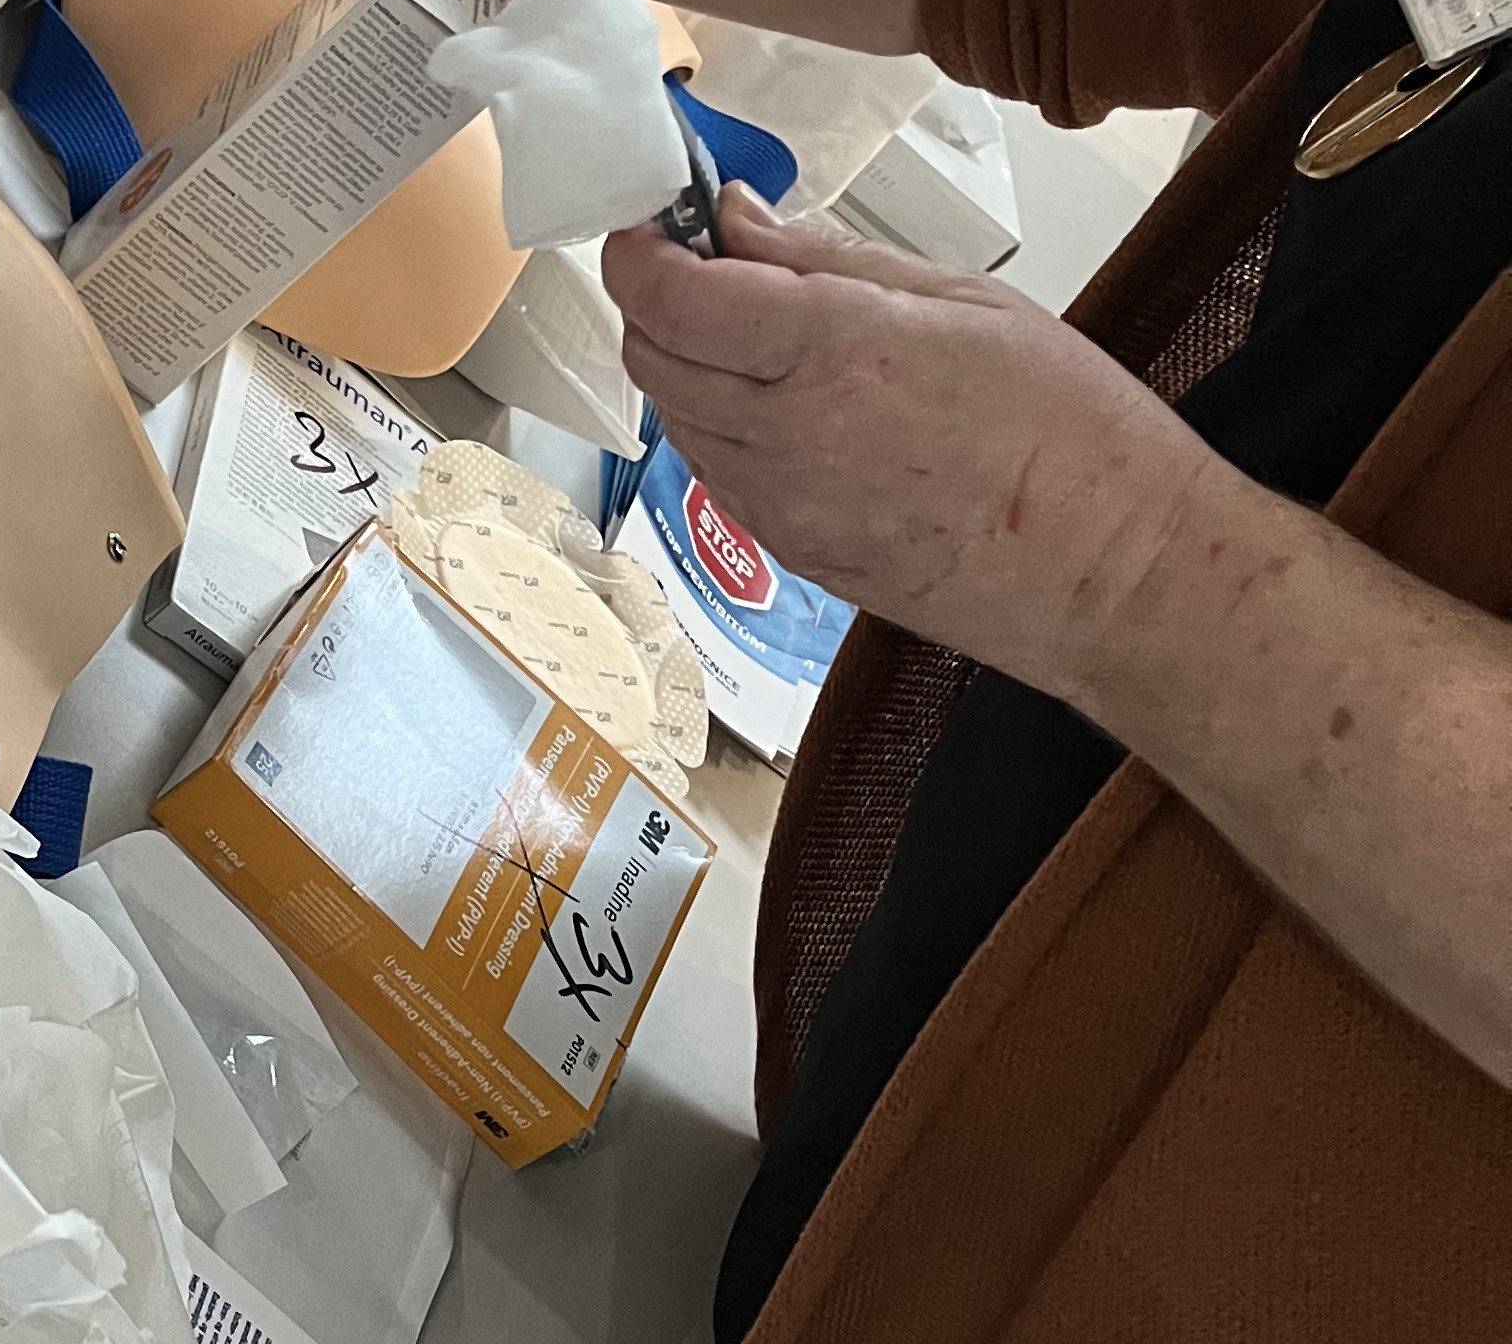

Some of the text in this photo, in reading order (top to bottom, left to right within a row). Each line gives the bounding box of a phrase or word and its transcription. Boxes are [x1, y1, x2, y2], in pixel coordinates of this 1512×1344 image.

[652, 506, 684, 556] STOP
[695, 505, 755, 583] STOP
[601, 807, 673, 925] 3M Inadine
[483, 909, 536, 980] Dressing
[370, 970, 420, 1022] Dressing
[416, 1015, 494, 1094] Non-Adherent
[469, 1035, 494, 1062] non
[488, 1056, 551, 1118] Pansement
[472, 1104, 510, 1144] 3M
